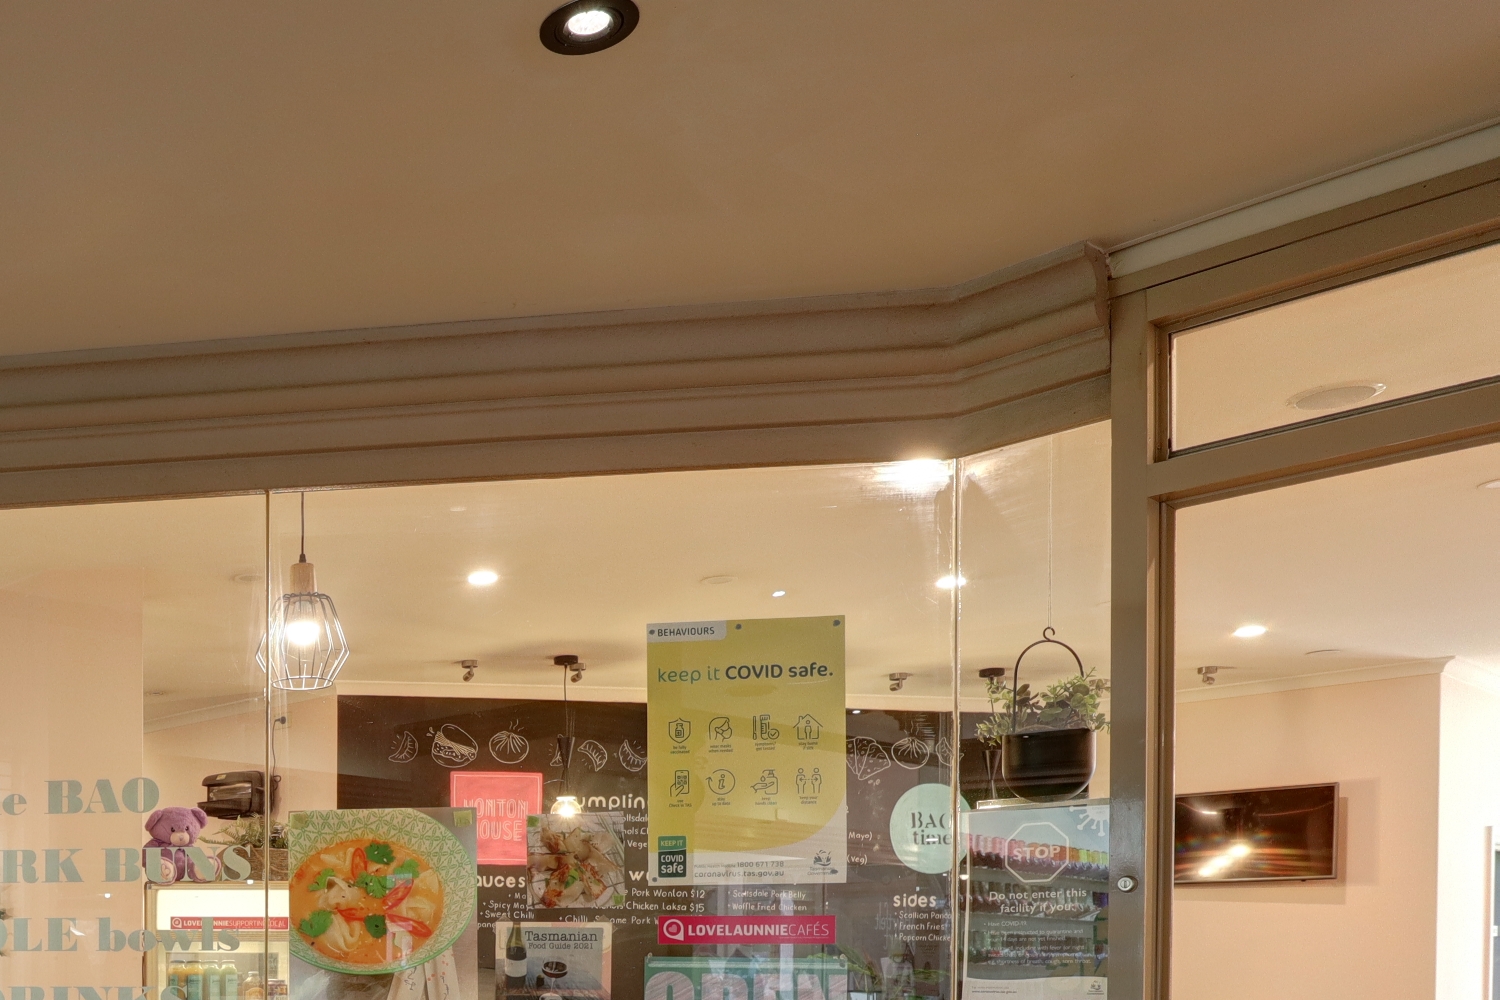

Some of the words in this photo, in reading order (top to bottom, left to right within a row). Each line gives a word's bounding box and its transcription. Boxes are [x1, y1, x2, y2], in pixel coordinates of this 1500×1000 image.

[657, 626, 716, 637] BEHAVIOURS
[657, 666, 702, 684] keep
[707, 665, 721, 681] it
[725, 664, 783, 680] COVID
[788, 661, 834, 678] safe.
[43, 775, 160, 816] BAO
[476, 818, 524, 842] OUSE
[676, 839, 684, 847] IT
[660, 854, 684, 863] COVID
[1013, 845, 1061, 861] STOP
[101, 842, 254, 884] BUNS
[660, 862, 684, 874] safe
[694, 870, 785, 878] coronavirus.tas.gov.au
[631, 888, 650, 898] Pork
[690, 889, 706, 899] $12
[788, 890, 807, 901] Belly
[989, 891, 1006, 901] Do
[1008, 890, 1028, 900] not
[1031, 889, 1062, 899] enter
[1066, 887, 1087, 897] this
[487, 900, 511, 911] Spicy
[625, 900, 659, 911] Chicken
[689, 902, 705, 913] $15
[892, 893, 937, 908] sides
[1000, 902, 1037, 914] facility
[1039, 902, 1047, 912] if
[631, 915, 651, 925] Pork
[898, 910, 929, 920] Scallion
[688, 921, 830, 937] LOVELAUNNIECAFÉS
[898, 921, 925, 930] French
[96, 915, 242, 953] bowls
[524, 930, 599, 942] Tasmanian
[898, 932, 927, 942] Popcorn
[528, 942, 547, 950] Food
[548, 942, 572, 950] Guide
[573, 942, 594, 950] 2021
